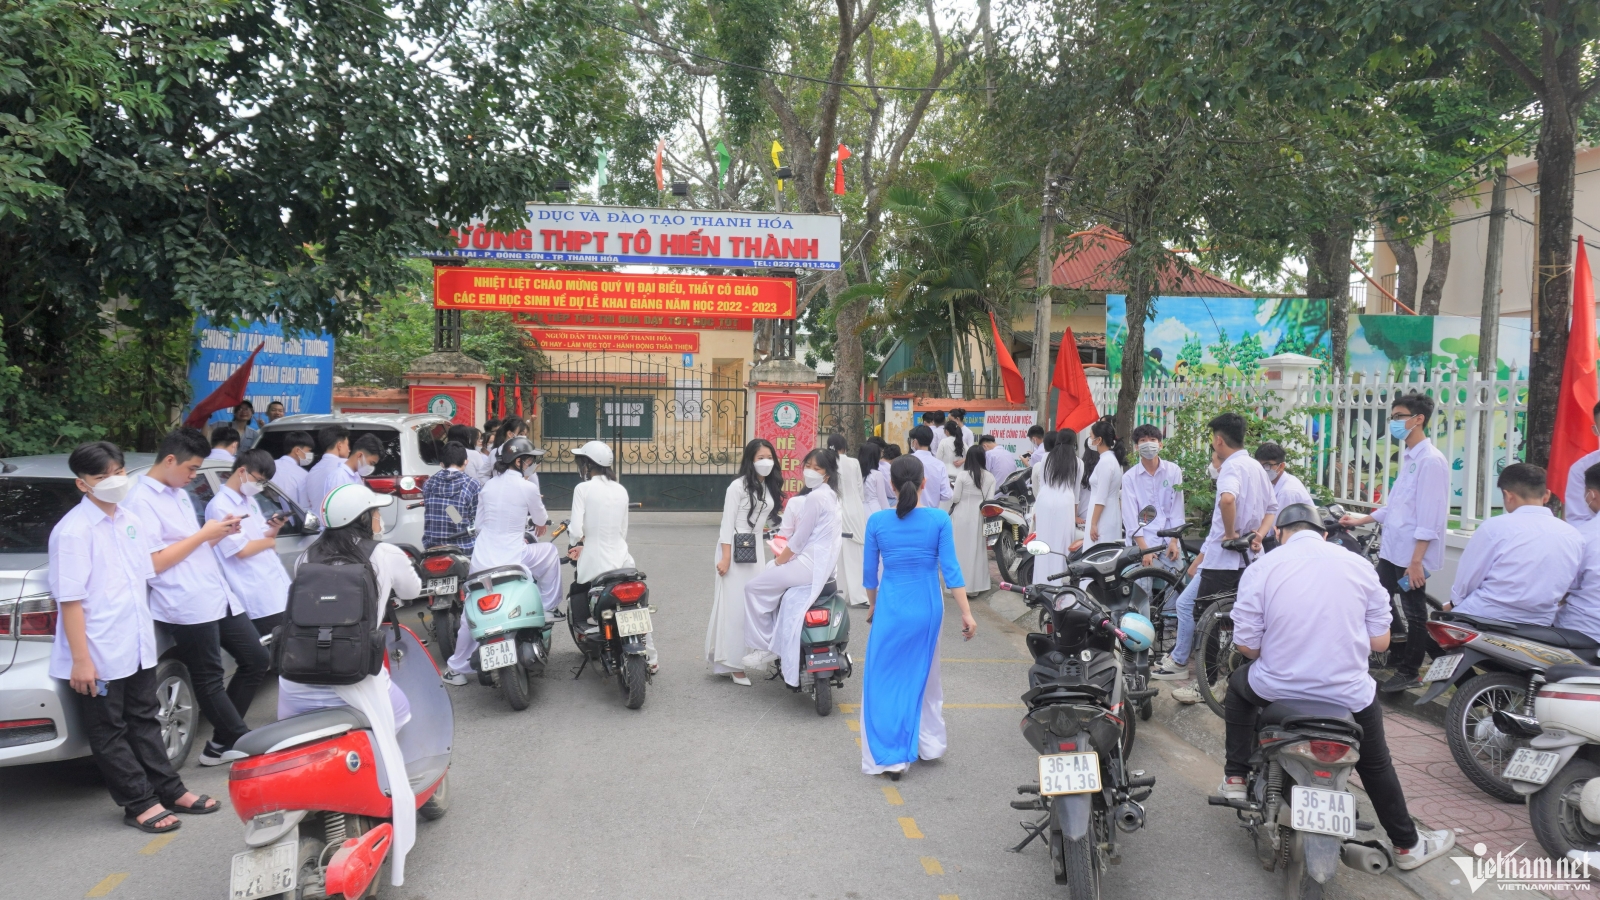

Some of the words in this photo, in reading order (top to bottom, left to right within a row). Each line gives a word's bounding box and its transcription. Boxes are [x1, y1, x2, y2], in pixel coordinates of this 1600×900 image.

[538, 209, 574, 222] DỤC
[580, 210, 600, 222] VÀ
[607, 211, 644, 223] ĐÀO
[650, 214, 685, 226] TẠO
[690, 216, 751, 228] THANH
[757, 217, 794, 229] HÓA
[436, 223, 532, 250] ƯỜNG
[540, 229, 608, 253] THPT
[618, 228, 652, 254] TÔ
[660, 228, 720, 256] HIẾN
[729, 234, 818, 259] THÀNH
[474, 275, 506, 290] NHIỆT
[508, 276, 531, 291] LIỆT
[534, 277, 562, 290] CHÀO
[566, 278, 598, 291] MỪNG
[601, 281, 621, 292] QUÝ
[625, 282, 635, 295] VỊ
[638, 282, 655, 295] ĐẠI
[658, 280, 685, 295] BIỂU,
[689, 281, 714, 294] THẦY
[717, 284, 731, 295] CÔ
[734, 283, 758, 296] GIÁO
[454, 291, 476, 304] CÁC
[479, 294, 496, 304] EM
[499, 294, 520, 308] HỌC
[524, 295, 550, 306] SINH
[553, 293, 566, 306] VỀ
[569, 296, 585, 309] DỰ
[587, 294, 599, 308] LỄ
[602, 298, 627, 308] KHAI
[630, 294, 662, 310] GIẢNG
[666, 298, 690, 311] NĂM
[693, 301, 714, 313] HỌC
[717, 302, 742, 312] 2022
[752, 303, 777, 313] 2023
[598, 314, 615, 324] THI
[201, 329, 230, 350] CHUNG
[586, 332, 612, 340] THÀNH
[614, 332, 629, 341] PHỐ
[280, 367, 296, 384] GIAO
[298, 364, 319, 384] THÔNG
[987, 414, 1001, 423] KHÁCH
[1006, 428, 1018, 438] CÔNG
[780, 454, 800, 471] ẾP
[485, 642, 510, 657] 36-AA
[484, 653, 514, 669] 354.02
[1048, 756, 1090, 773] 36-AA
[1507, 764, 1548, 781] 409.62
[1044, 773, 1096, 792] 341.36
[1302, 790, 1345, 813] 36-AA
[1297, 810, 1350, 834] 345.00
